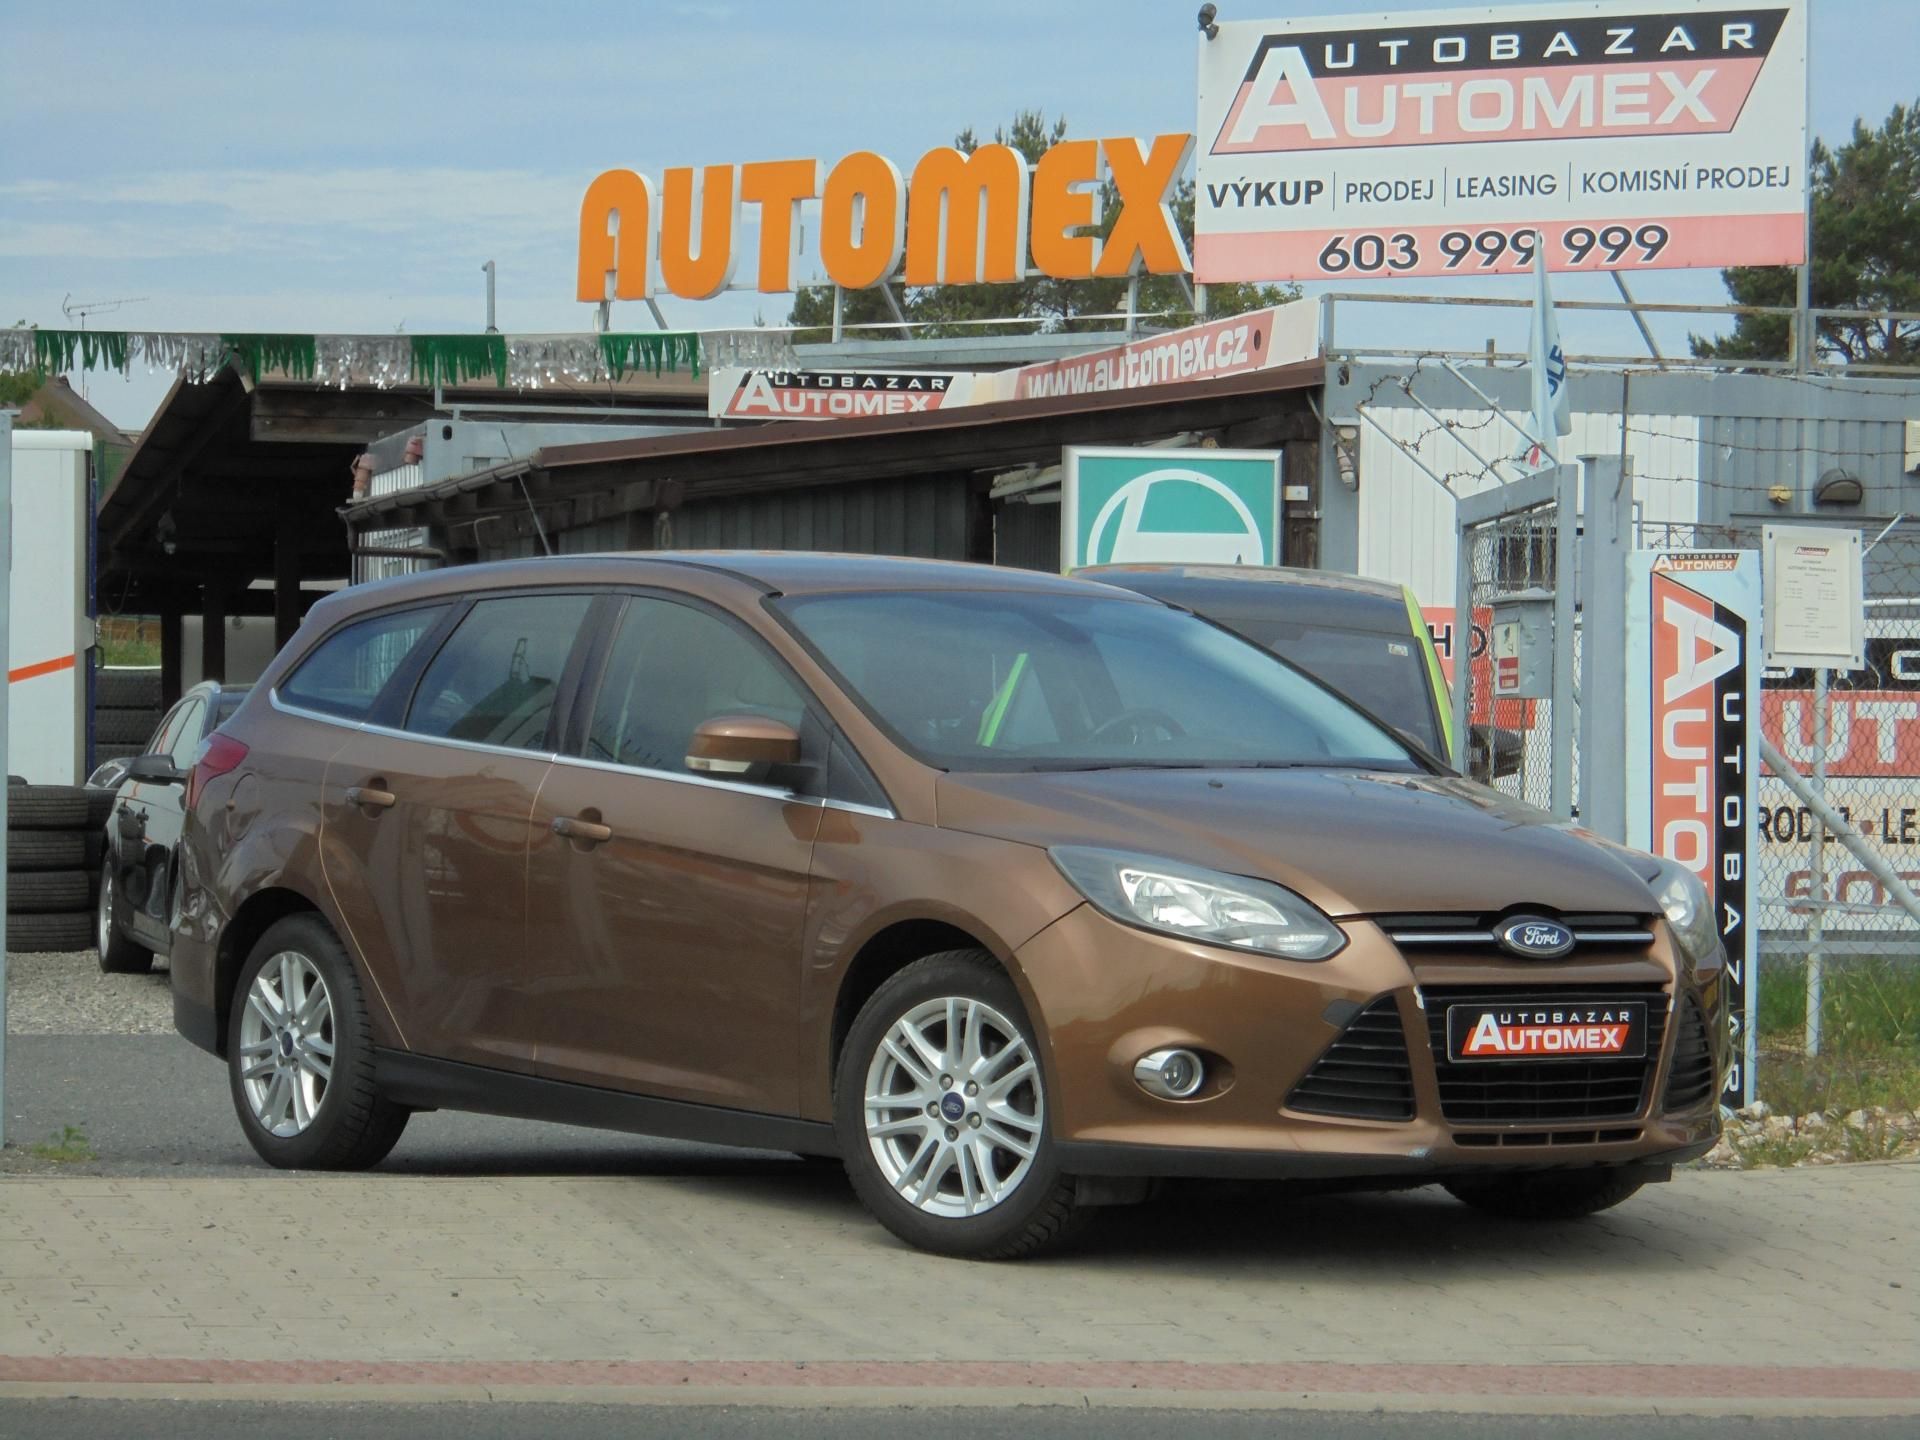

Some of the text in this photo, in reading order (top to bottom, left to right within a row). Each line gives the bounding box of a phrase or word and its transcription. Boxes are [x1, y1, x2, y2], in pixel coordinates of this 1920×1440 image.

[1227, 46, 1718, 144] AUTOMEX
[1207, 162, 1790, 209] VÝKUP PRODEJ LEASING KOMISNÍ PRODEJ
[577, 132, 1195, 303] AUTOMEX
[1317, 223, 1670, 273] 603 999 999
[1027, 325, 1249, 399] www.automex.cz
[735, 372, 931, 416] AUTOMEX
[1654, 554, 1733, 571] AUTOMEX
[1523, 926, 1561, 946] Ford
[1468, 1013, 1620, 1052] AUTOMEX
